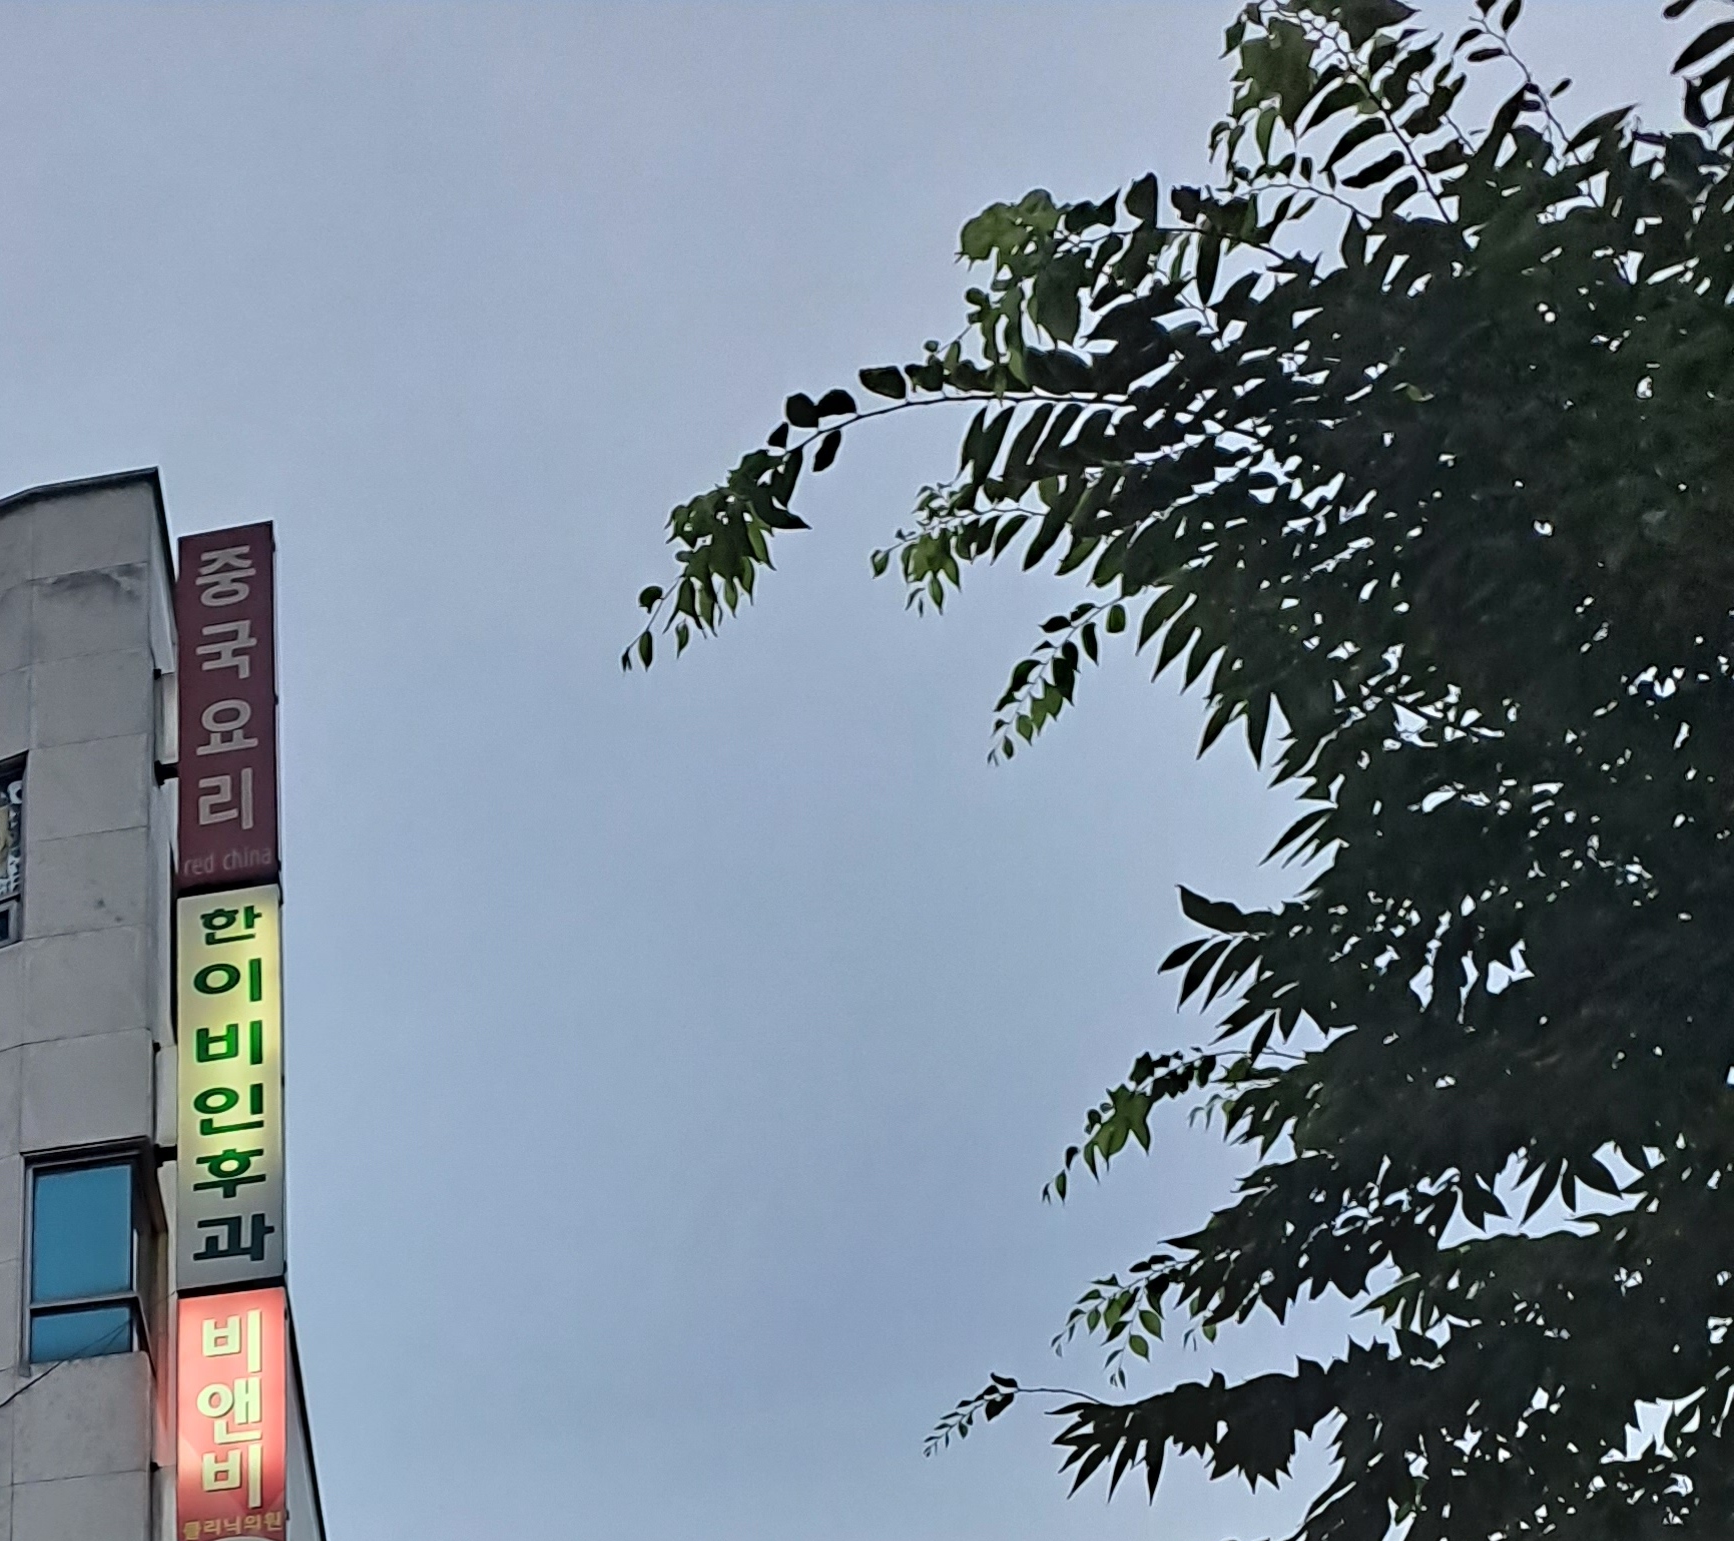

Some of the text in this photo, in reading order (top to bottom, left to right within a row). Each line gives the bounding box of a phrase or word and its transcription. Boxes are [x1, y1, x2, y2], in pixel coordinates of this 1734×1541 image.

[195, 545, 258, 830] 중국요리
[183, 848, 272, 876] red china
[193, 905, 274, 1262] 한이비인후과
[197, 1308, 262, 1509] 비앤비
[183, 1511, 282, 1541] 클리닉의원
